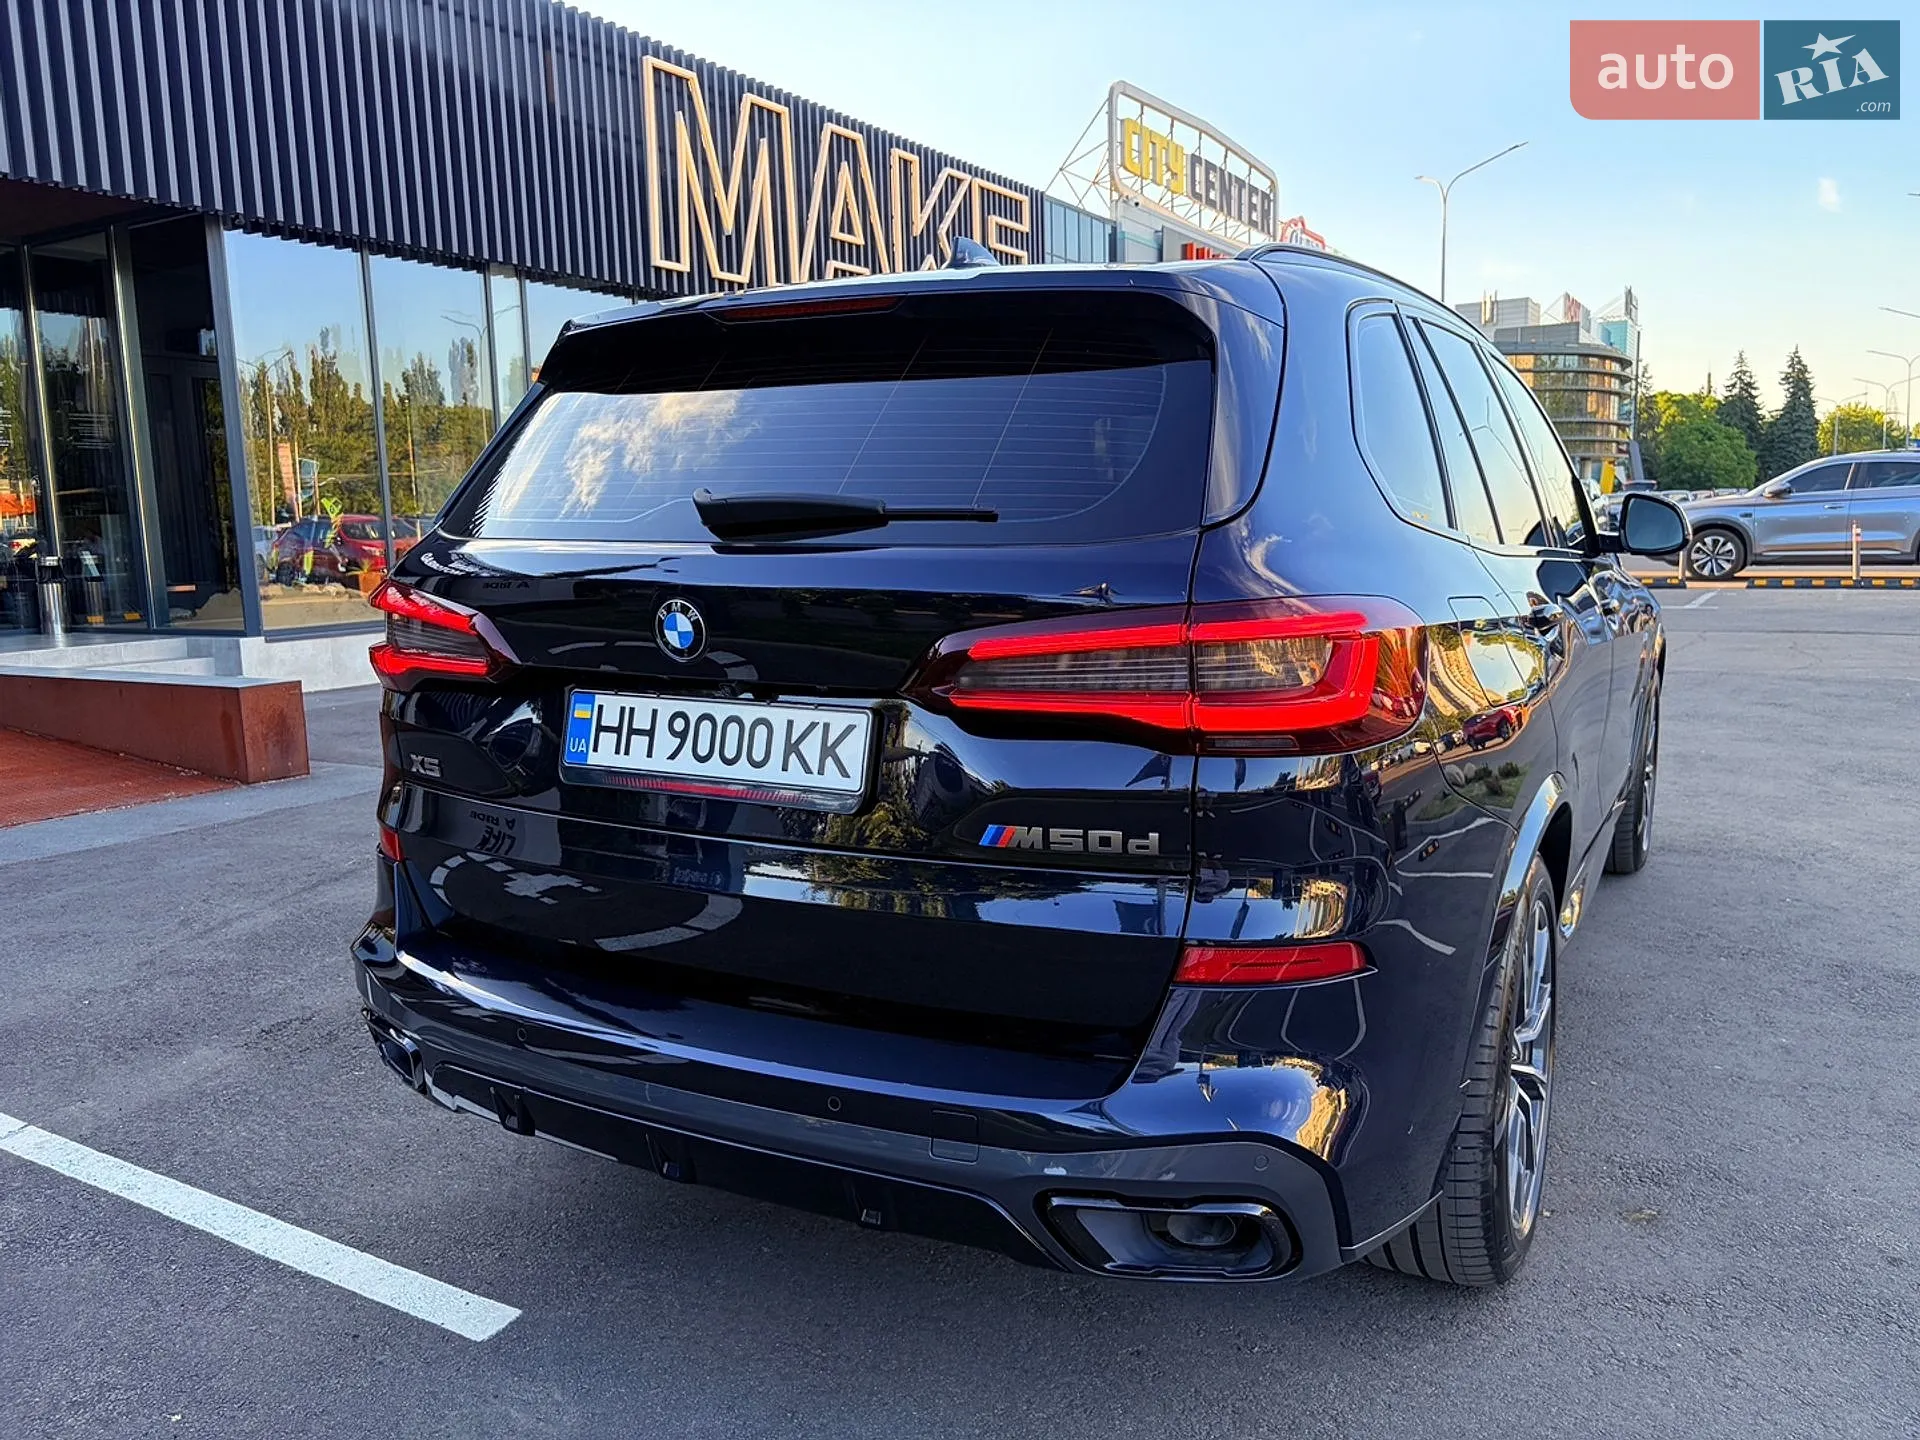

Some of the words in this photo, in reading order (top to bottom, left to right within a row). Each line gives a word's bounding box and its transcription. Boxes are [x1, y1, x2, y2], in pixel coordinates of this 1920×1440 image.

[643, 55, 1029, 287] MAKE
[1121, 118, 1184, 195] CITY
[1186, 153, 1271, 237] CENTER
[410, 754, 441, 778] X5
[569, 736, 587, 754] UA
[592, 704, 658, 759] HH
[666, 710, 774, 769] 9000
[781, 719, 857, 779] KK
[1007, 826, 1160, 856] M50d
